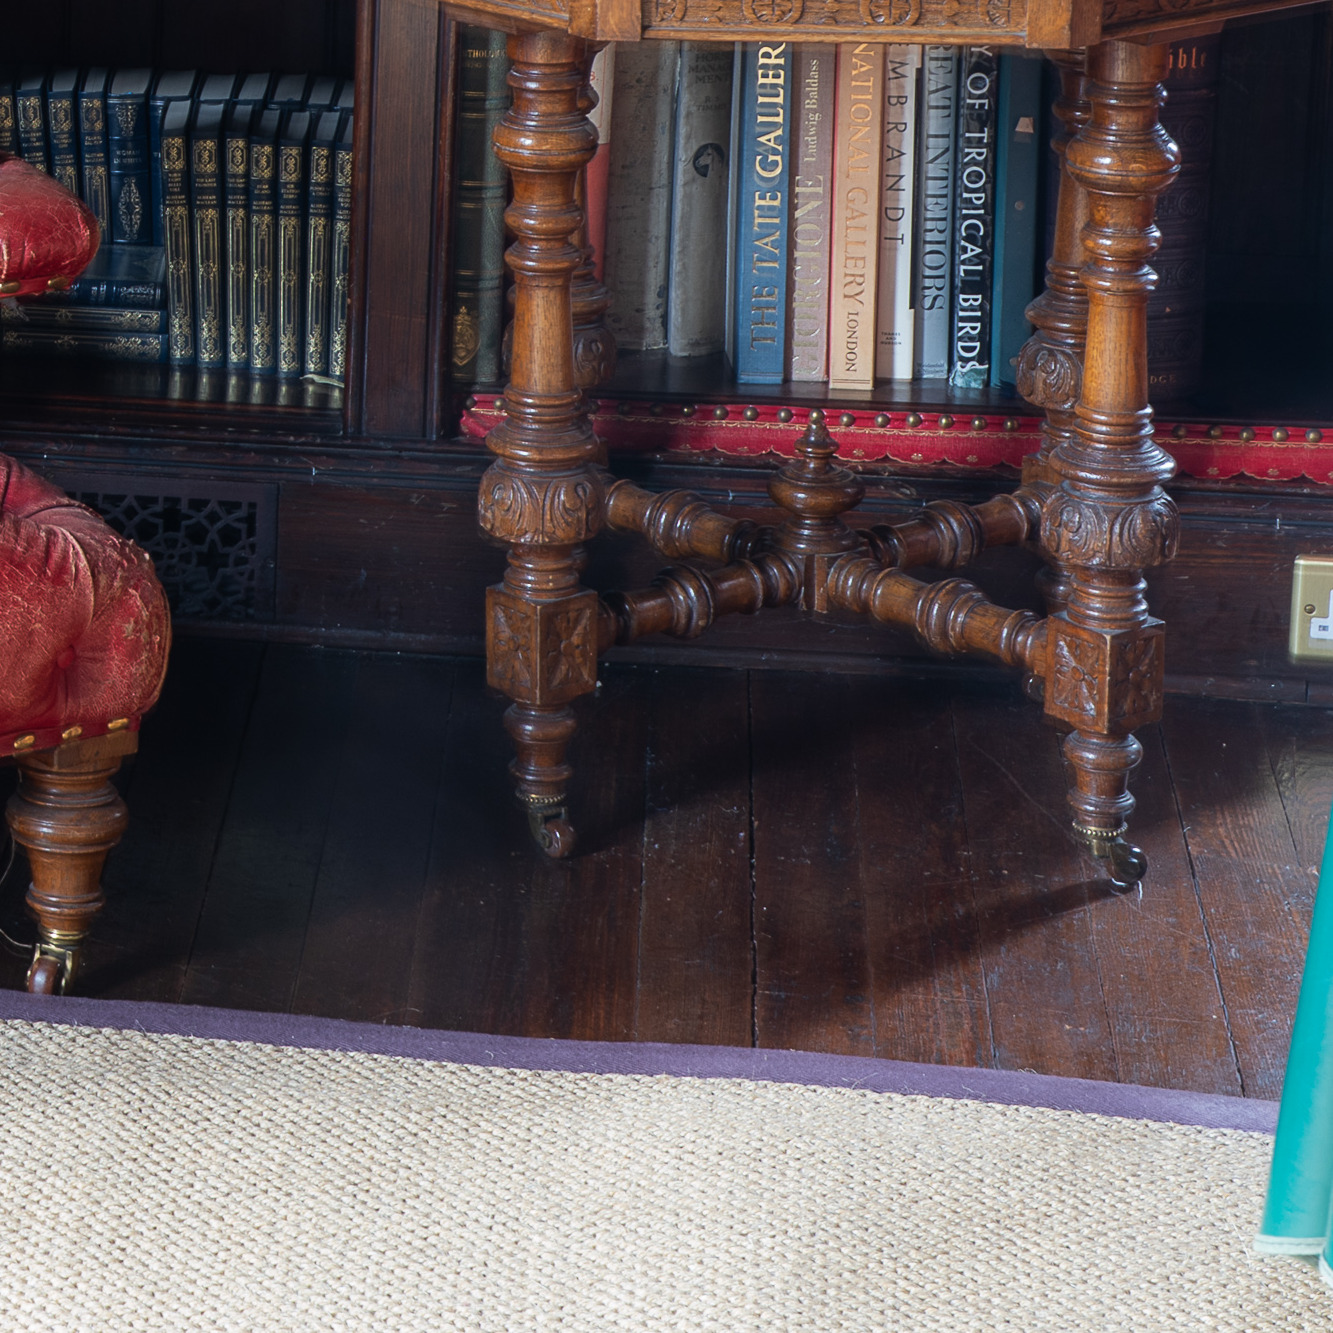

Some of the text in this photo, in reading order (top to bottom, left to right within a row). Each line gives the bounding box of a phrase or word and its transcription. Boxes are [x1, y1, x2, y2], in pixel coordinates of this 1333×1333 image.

[751, 42, 787, 353] THE TATE GALLER
[803, 58, 822, 164] Ludwig Baldass
[843, 42, 876, 374] NATIONAL GALLERY LONDON
[919, 44, 953, 312] REAT INTERIORS
[956, 72, 990, 373] OF TROPICAL BIRDS
[792, 174, 824, 377] GIORGIONE
